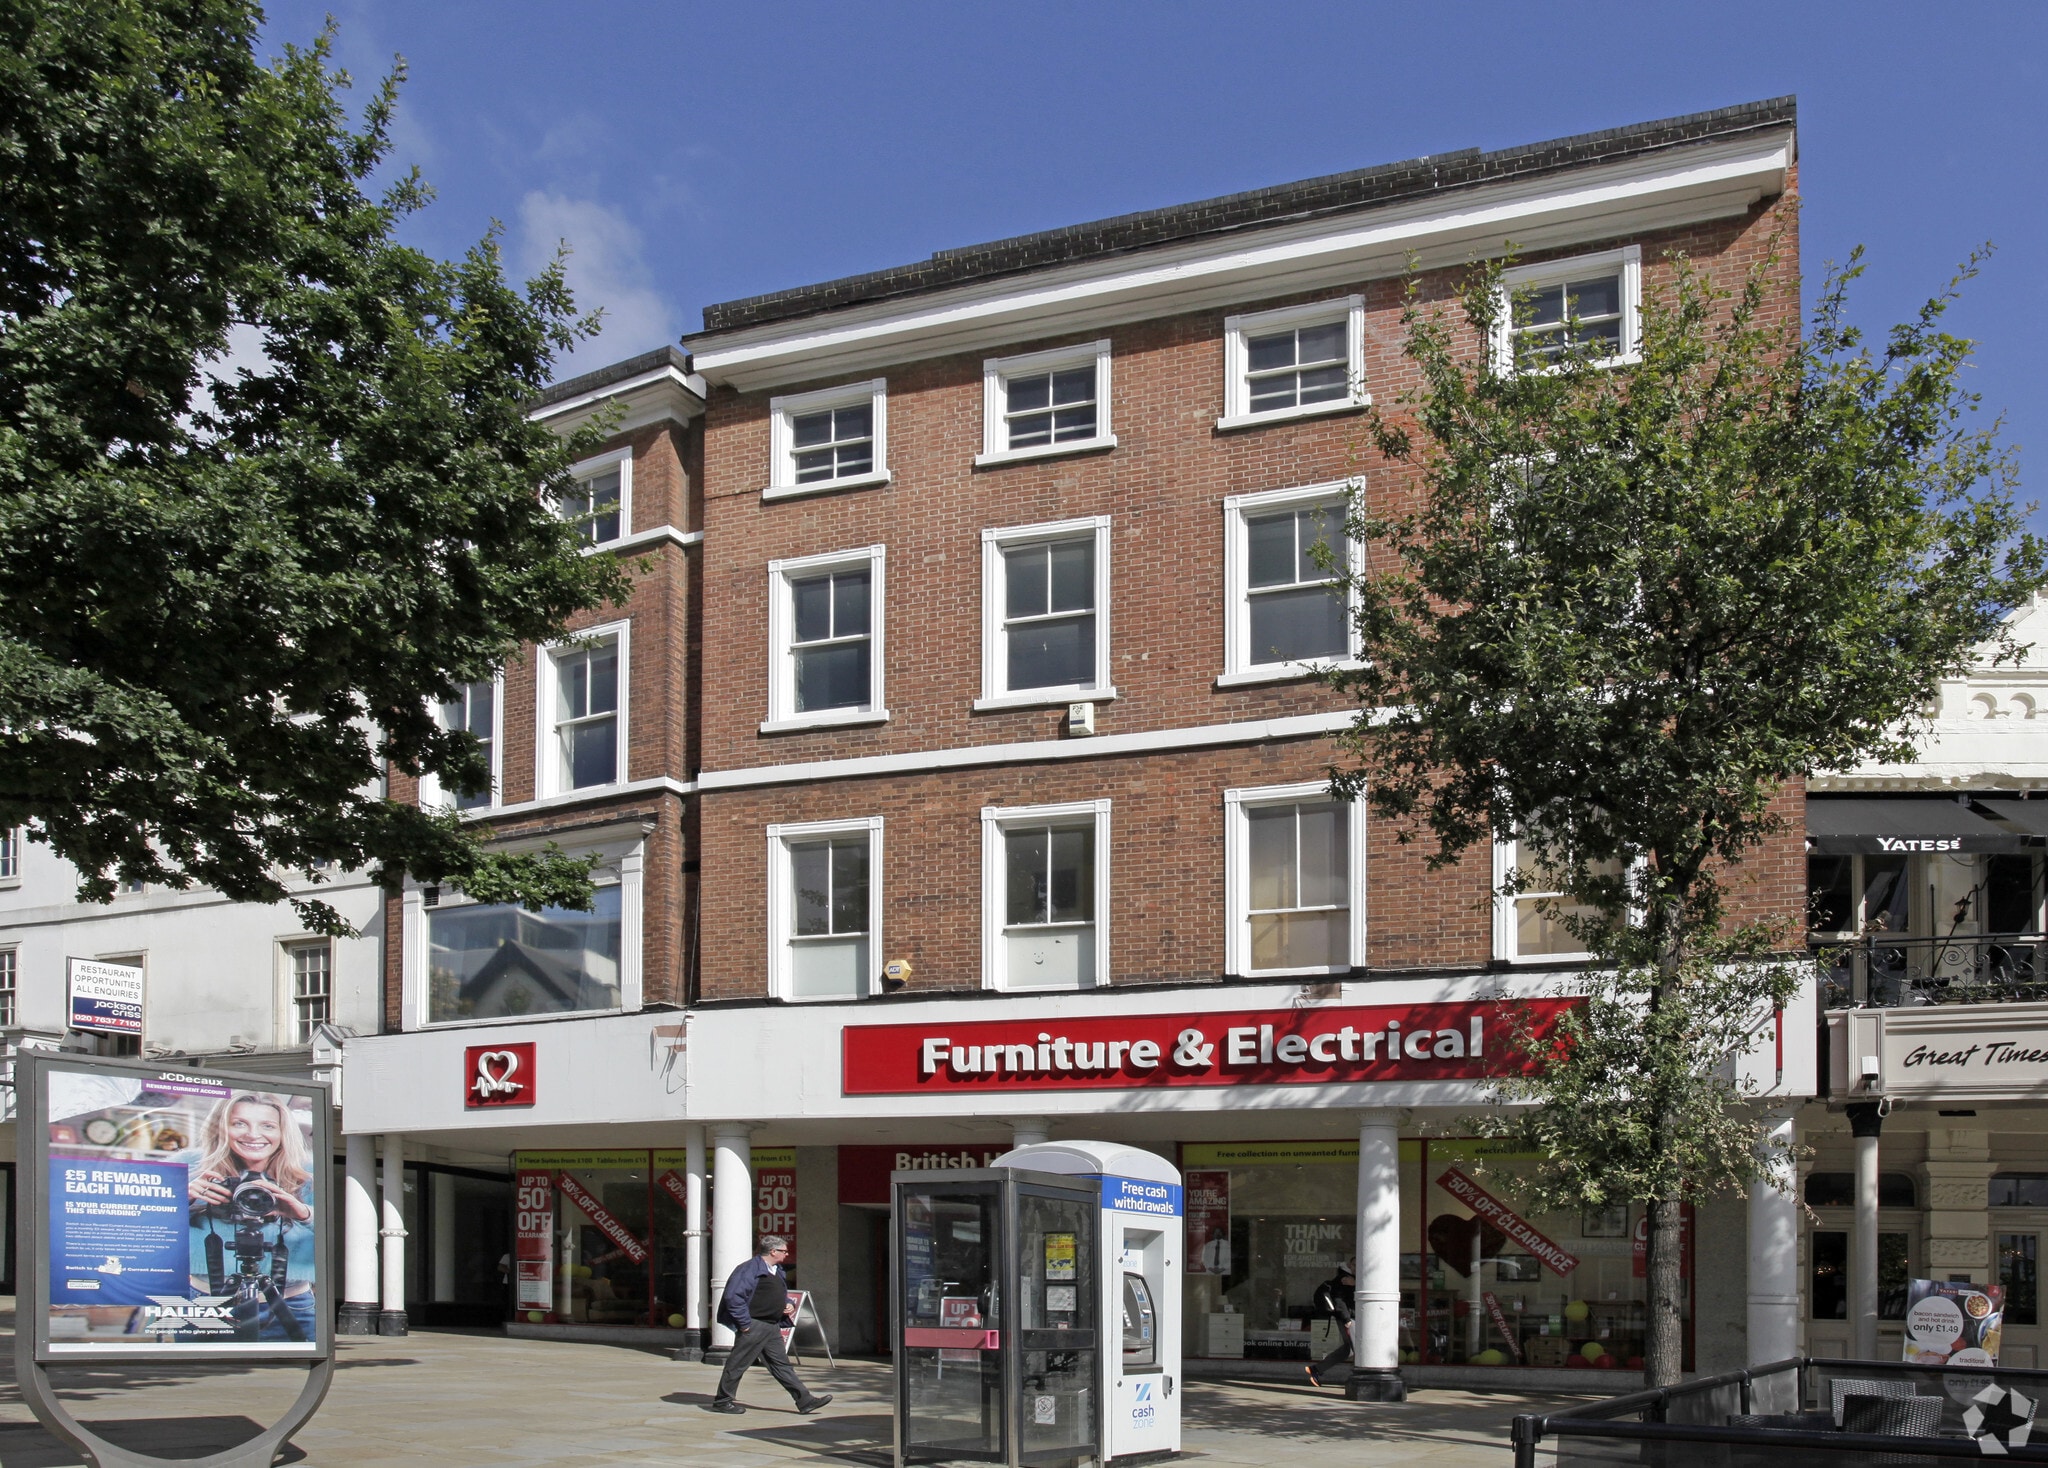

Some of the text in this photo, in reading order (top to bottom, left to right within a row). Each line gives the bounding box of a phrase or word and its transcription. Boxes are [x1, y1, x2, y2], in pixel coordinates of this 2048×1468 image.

[80, 965, 136, 979] RESTAURANT
[888, 966, 901, 974] ADT
[74, 974, 141, 990] OPPORTUNITIES
[75, 985, 139, 1000] ALL ENQUIRIES
[94, 1001, 142, 1012] jackson
[112, 1009, 141, 1018] criss
[75, 1014, 141, 1028] 020 7637 7100
[921, 1015, 1484, 1075] Furniture & Electrical
[1903, 1041, 2048, 1068] Great Times
[158, 1072, 223, 1086] JCDecaux
[145, 1082, 227, 1096] REWARD CURRENT ACCOUNT
[895, 1151, 978, 1170] British
[1237, 1150, 1278, 1158] collection
[1338, 1149, 1360, 1157] furni
[65, 1169, 162, 1185] £5 REWARD
[521, 1176, 548, 1186] UP TO
[762, 1175, 792, 1186] UP TO
[65, 1181, 176, 1199] EACH MONTH.
[1121, 1181, 1167, 1199] Free cash
[1188, 1189, 1217, 1198] YOU'RE
[518, 1187, 551, 1210] 50%
[758, 1186, 796, 1211] 50%
[1114, 1196, 1174, 1214] withdrawals
[1188, 1197, 1227, 1205] AMAZING
[86, 1208, 142, 1217] REWARDING?
[100, 1203, 138, 1211] CURRENT
[140, 1204, 178, 1213] ACCOUNT
[517, 1211, 552, 1231] OFF
[561, 1178, 583, 1200] 50%
[578, 1195, 600, 1213] OFF
[593, 1209, 647, 1261] CLEARANCE
[758, 1213, 796, 1233] OFF
[1447, 1176, 1480, 1202] 50%
[1474, 1197, 1501, 1217] OFF
[1496, 1213, 1574, 1272] CLEARANCE
[1284, 1224, 1343, 1240] THANK
[1284, 1239, 1318, 1254] YOU
[144, 1306, 234, 1318] HALIFAX
[950, 1303, 968, 1315] UP
[1933, 1311, 1960, 1319] sandwich
[1913, 1324, 1959, 1334] only £1.49
[1257, 1339, 1283, 1347] online
[1948, 1379, 1968, 1388] only
[1132, 1404, 1155, 1418] cash
[1132, 1418, 1155, 1430] zone
